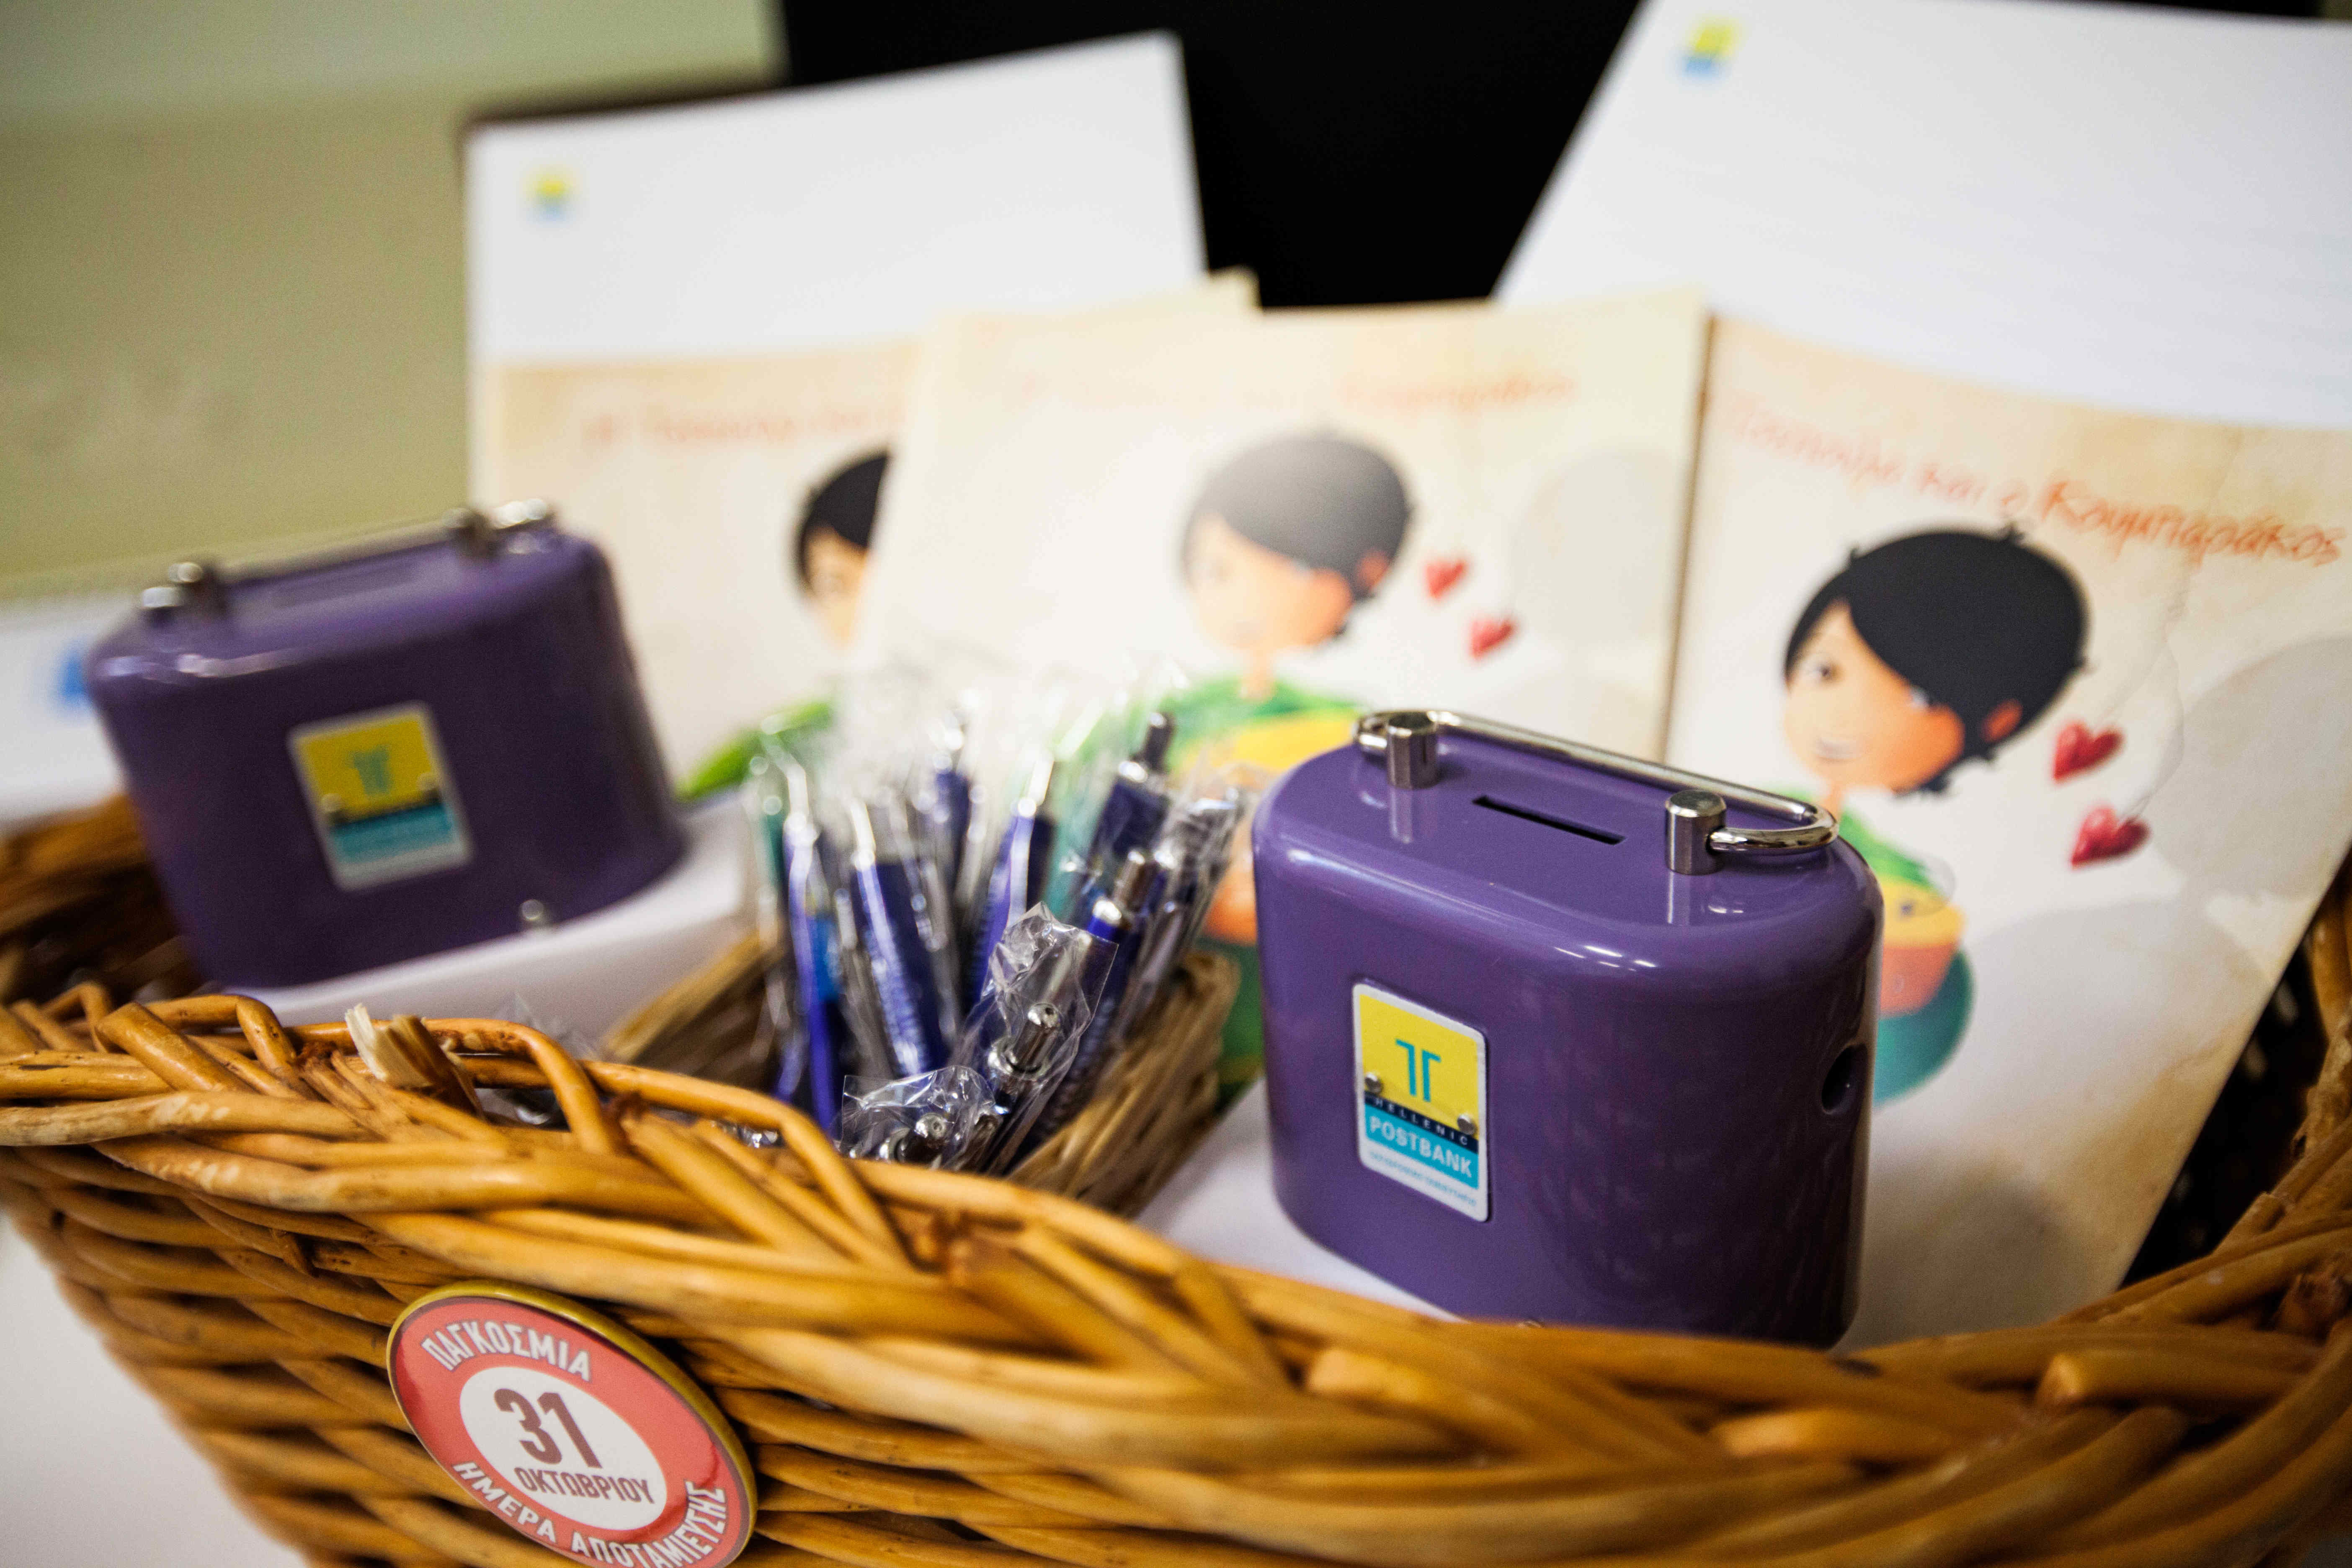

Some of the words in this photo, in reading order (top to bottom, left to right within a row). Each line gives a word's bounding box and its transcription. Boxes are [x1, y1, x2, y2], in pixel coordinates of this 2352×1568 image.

[1369, 1115, 1472, 1178] POSTBANK
[1375, 1098, 1468, 1145] HELLENIC
[420, 1320, 591, 1382] ΠΑΓΚΟΣΜΙΑ
[493, 1388, 603, 1468] 31
[453, 1461, 557, 1543] ΗΜΕΡΑ
[571, 1478, 727, 1568] ΑΠΟΤΑΜΙΕΥΣΗΣ
[513, 1466, 655, 1504] ΟΚΤΩΒΡΙΟΥ
